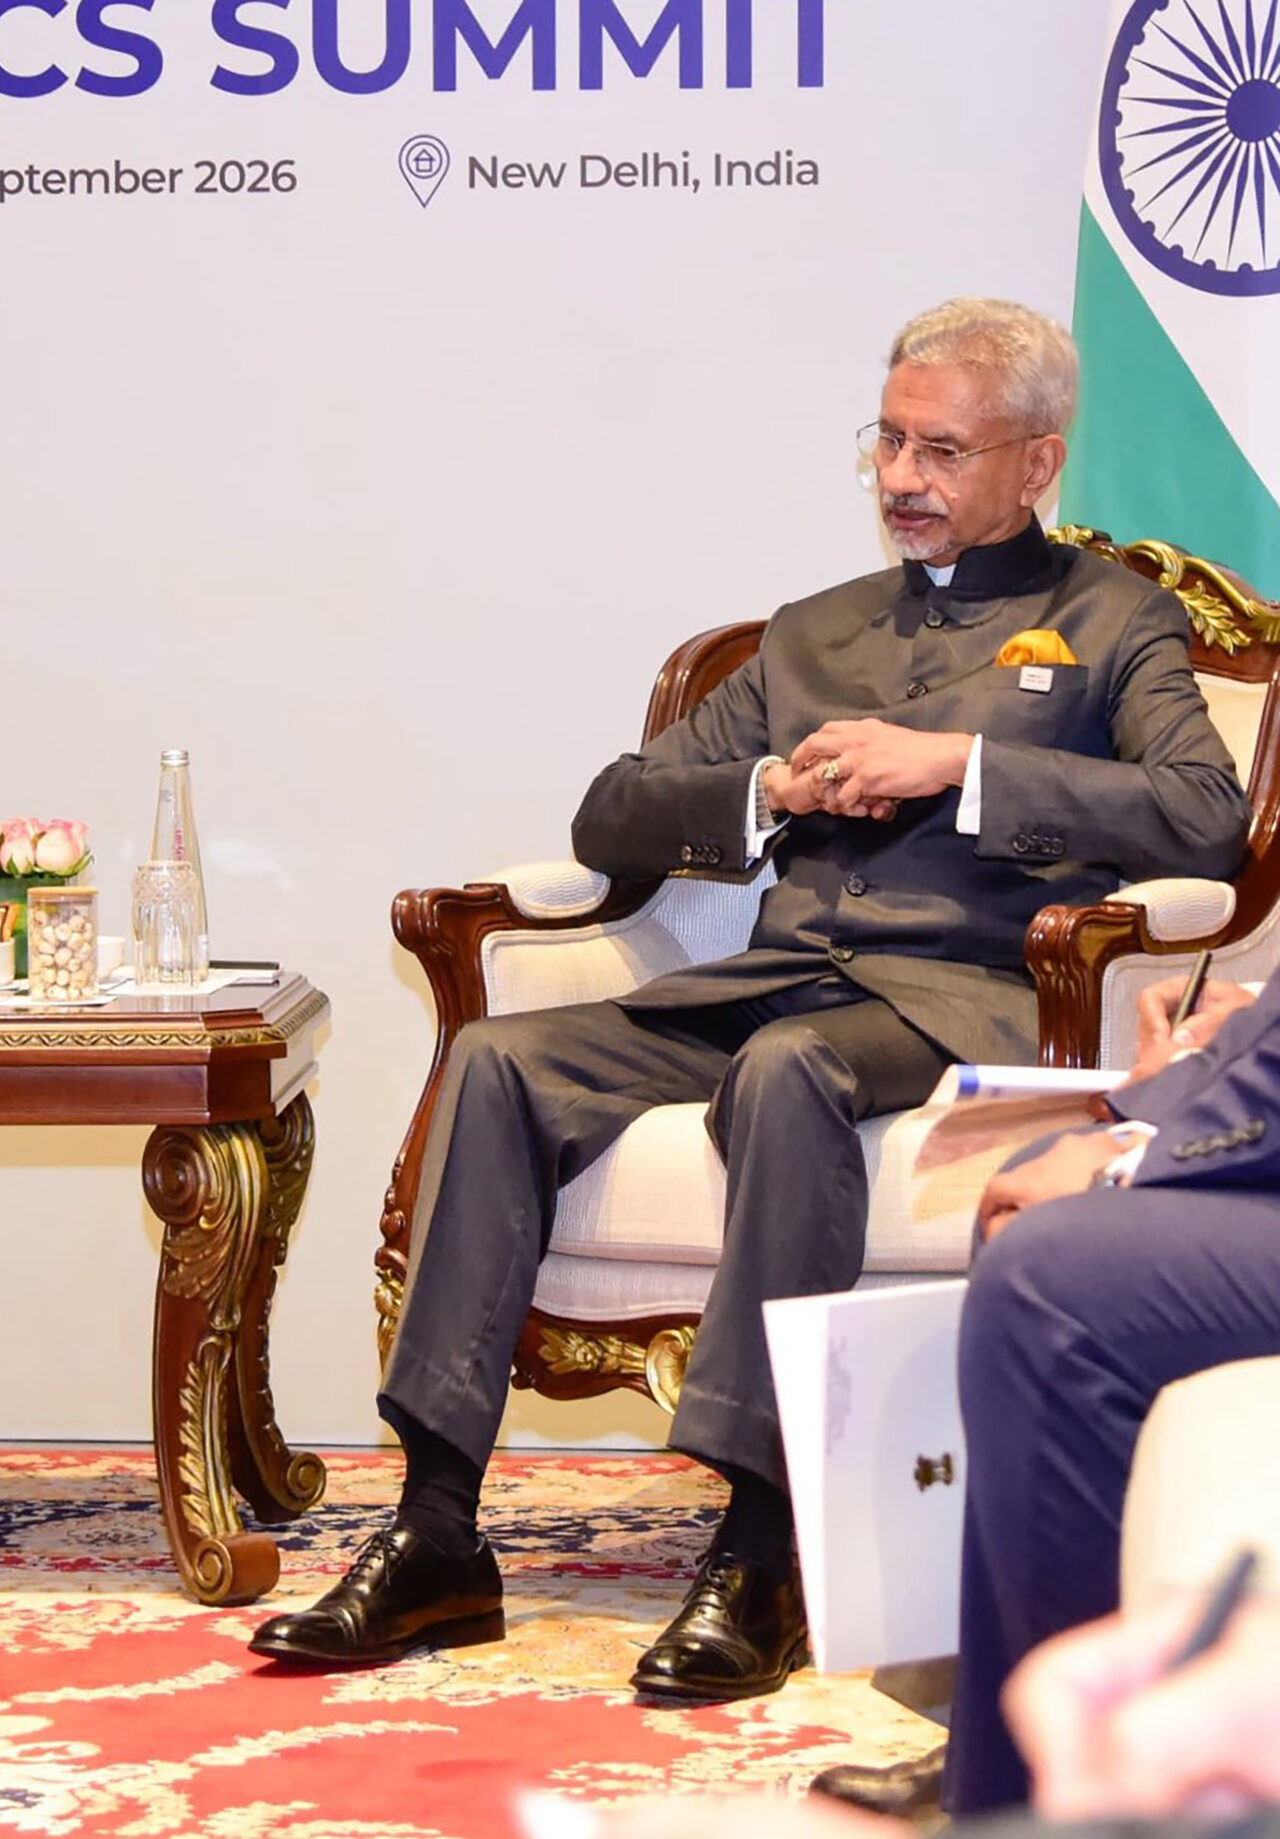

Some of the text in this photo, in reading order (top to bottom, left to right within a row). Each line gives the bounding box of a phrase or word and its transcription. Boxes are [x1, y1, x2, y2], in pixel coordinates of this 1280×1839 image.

[193, 159, 298, 194] 2026
[468, 149, 819, 194] New Delhi, India
